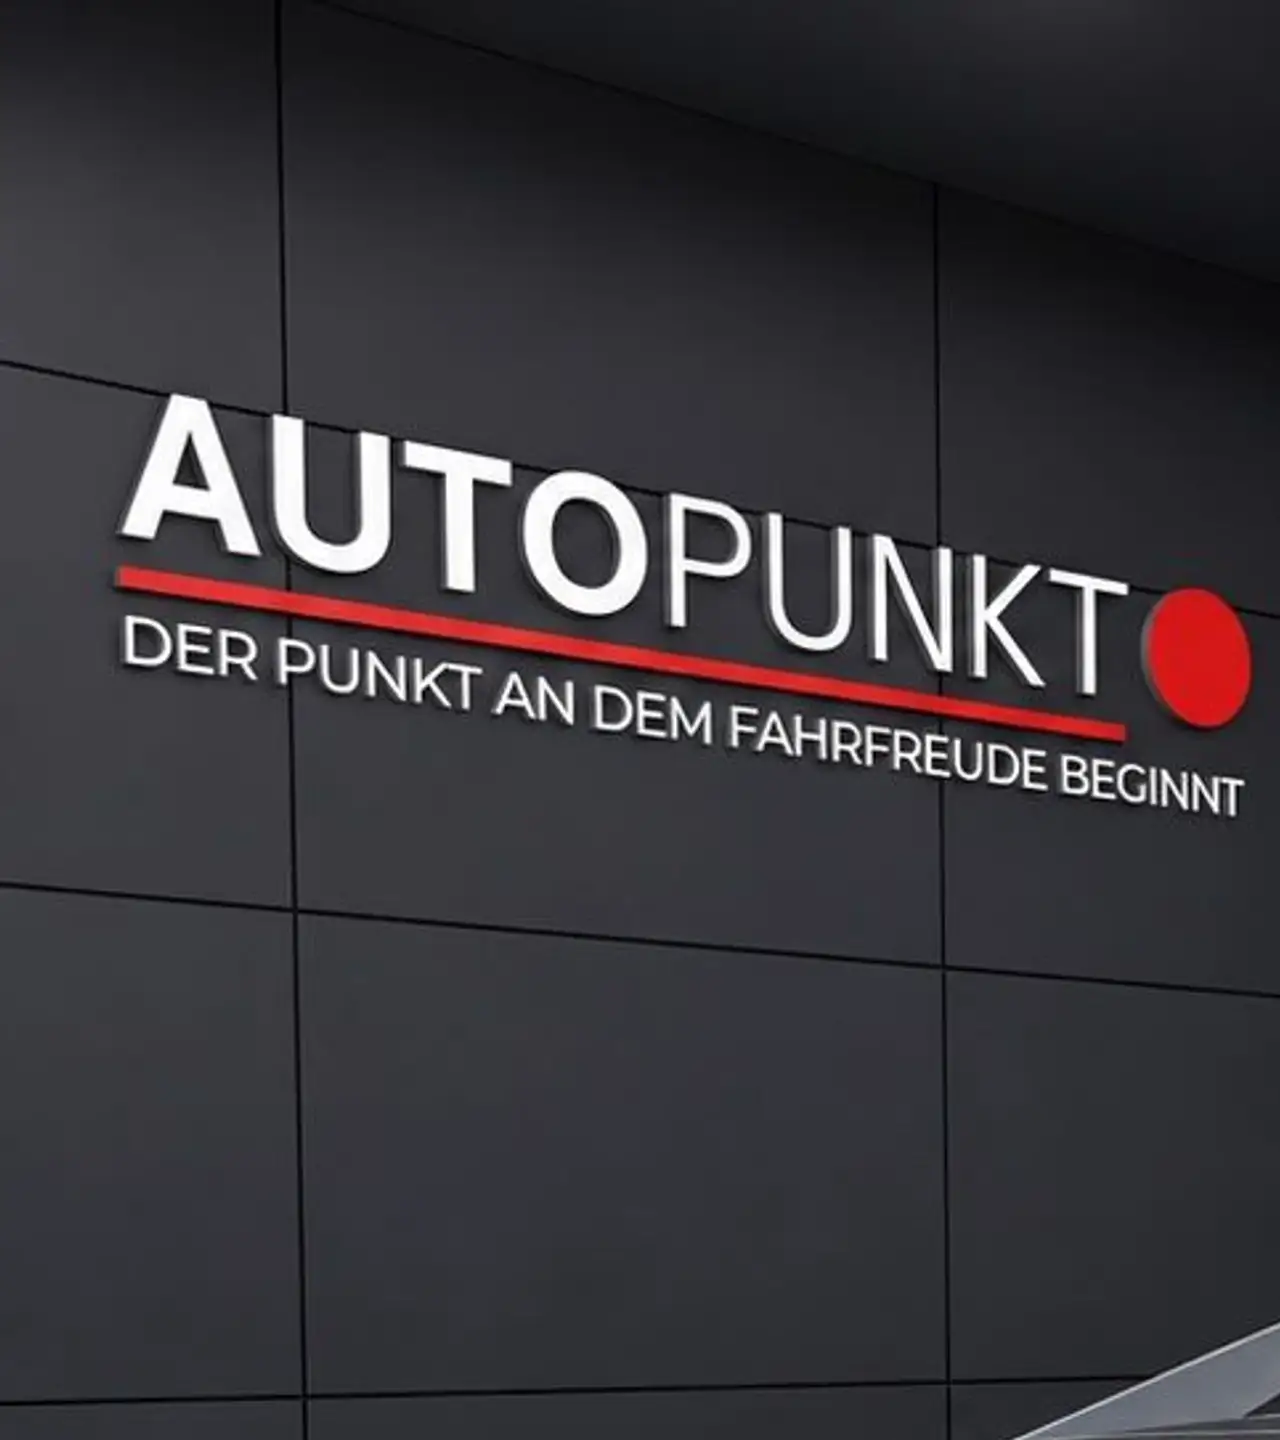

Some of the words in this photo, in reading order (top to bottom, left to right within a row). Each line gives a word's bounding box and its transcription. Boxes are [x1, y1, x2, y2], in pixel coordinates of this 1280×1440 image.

[118, 392, 1129, 695] AUTOPUNKT
[122, 614, 258, 682] DER
[277, 635, 484, 711] PUNKT
[493, 670, 575, 726] AN
[593, 684, 713, 745] DEM
[729, 704, 1049, 792] FAHRFREUDE
[1060, 753, 1246, 817] BEGINNT
